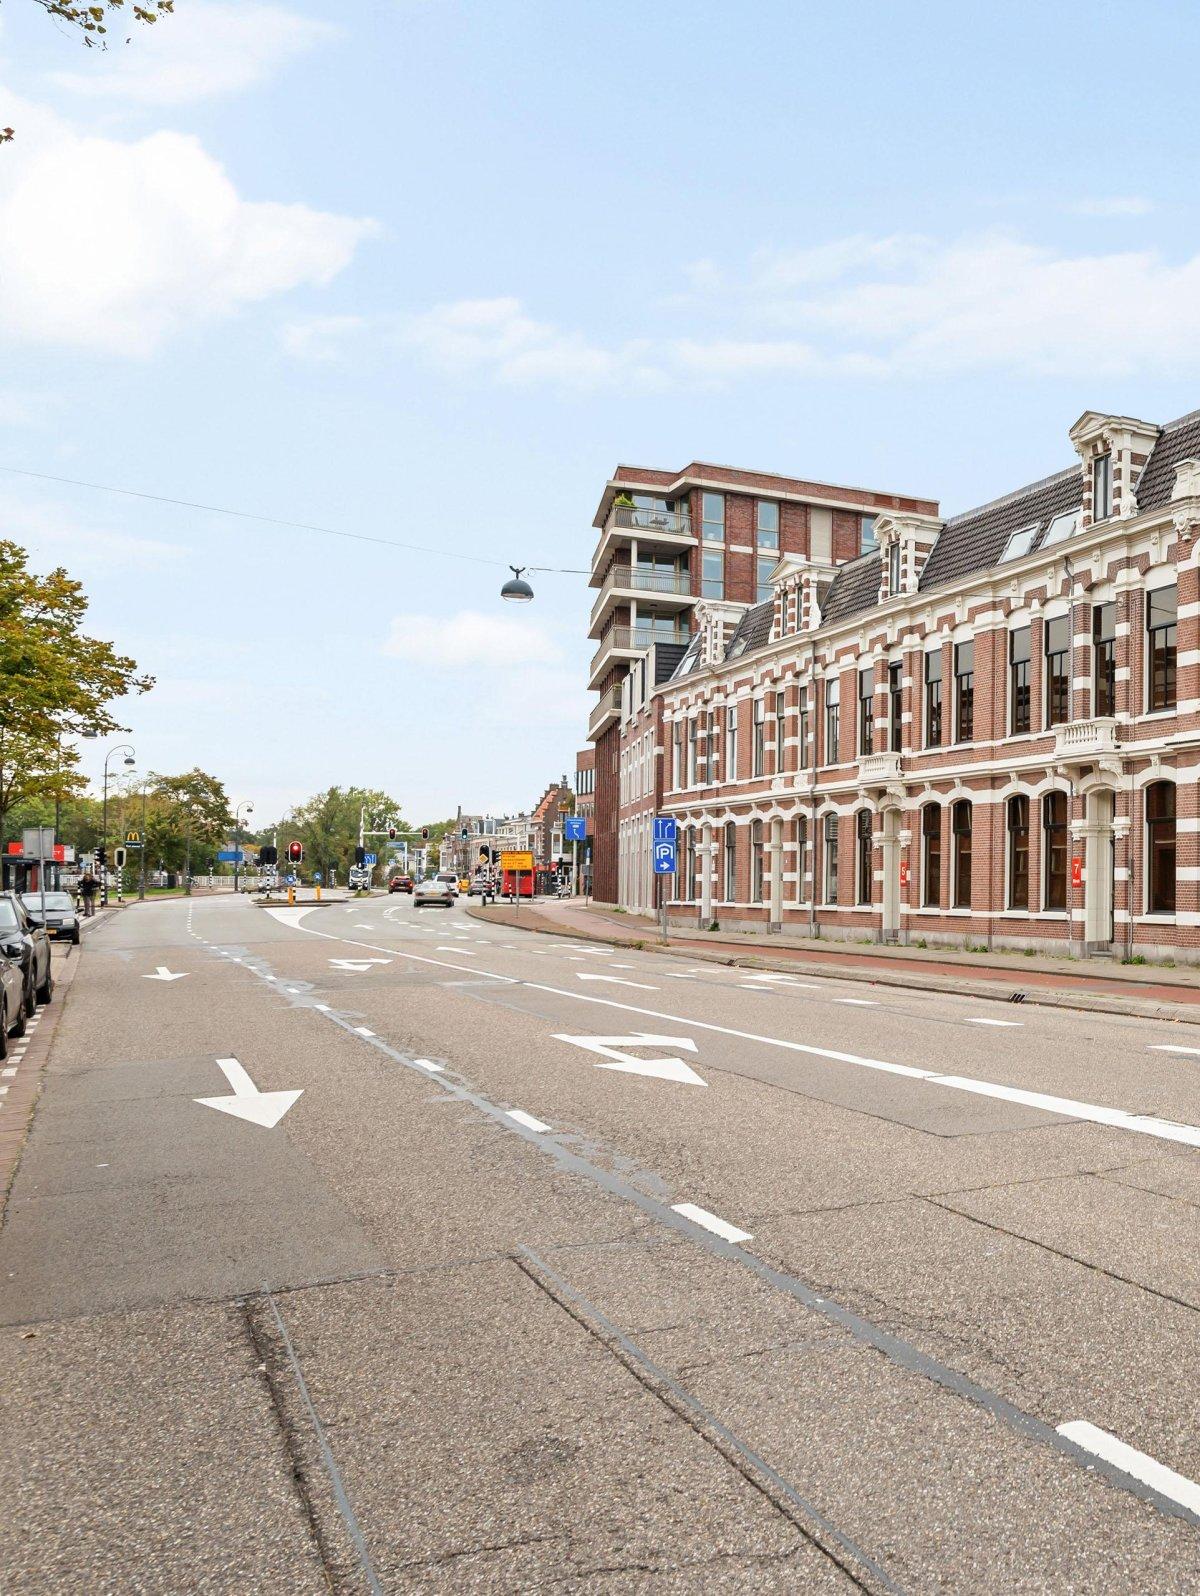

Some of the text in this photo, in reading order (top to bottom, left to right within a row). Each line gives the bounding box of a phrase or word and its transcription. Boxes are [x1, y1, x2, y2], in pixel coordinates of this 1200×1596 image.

[660, 847, 670, 859] P
[901, 866, 906, 876] 5
[1074, 863, 1079, 874] 7
